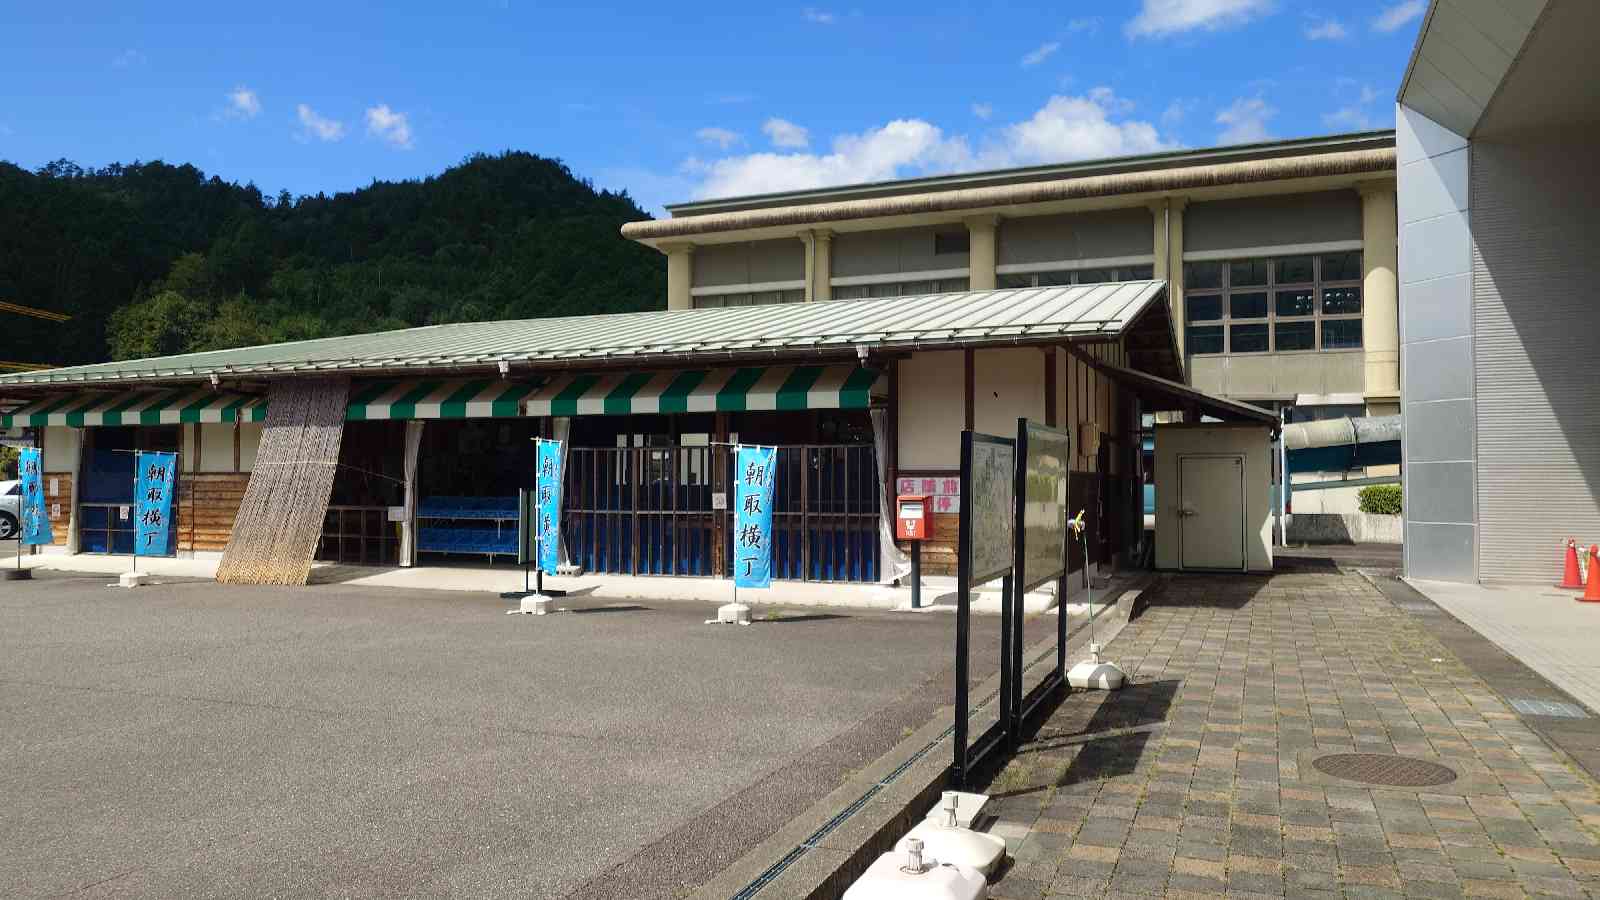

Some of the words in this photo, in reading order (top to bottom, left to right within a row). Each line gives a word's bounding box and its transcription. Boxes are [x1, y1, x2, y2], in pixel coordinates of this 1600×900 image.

[142, 463, 166, 545] 朝取横丁
[740, 461, 764, 577] 朝取横丁
